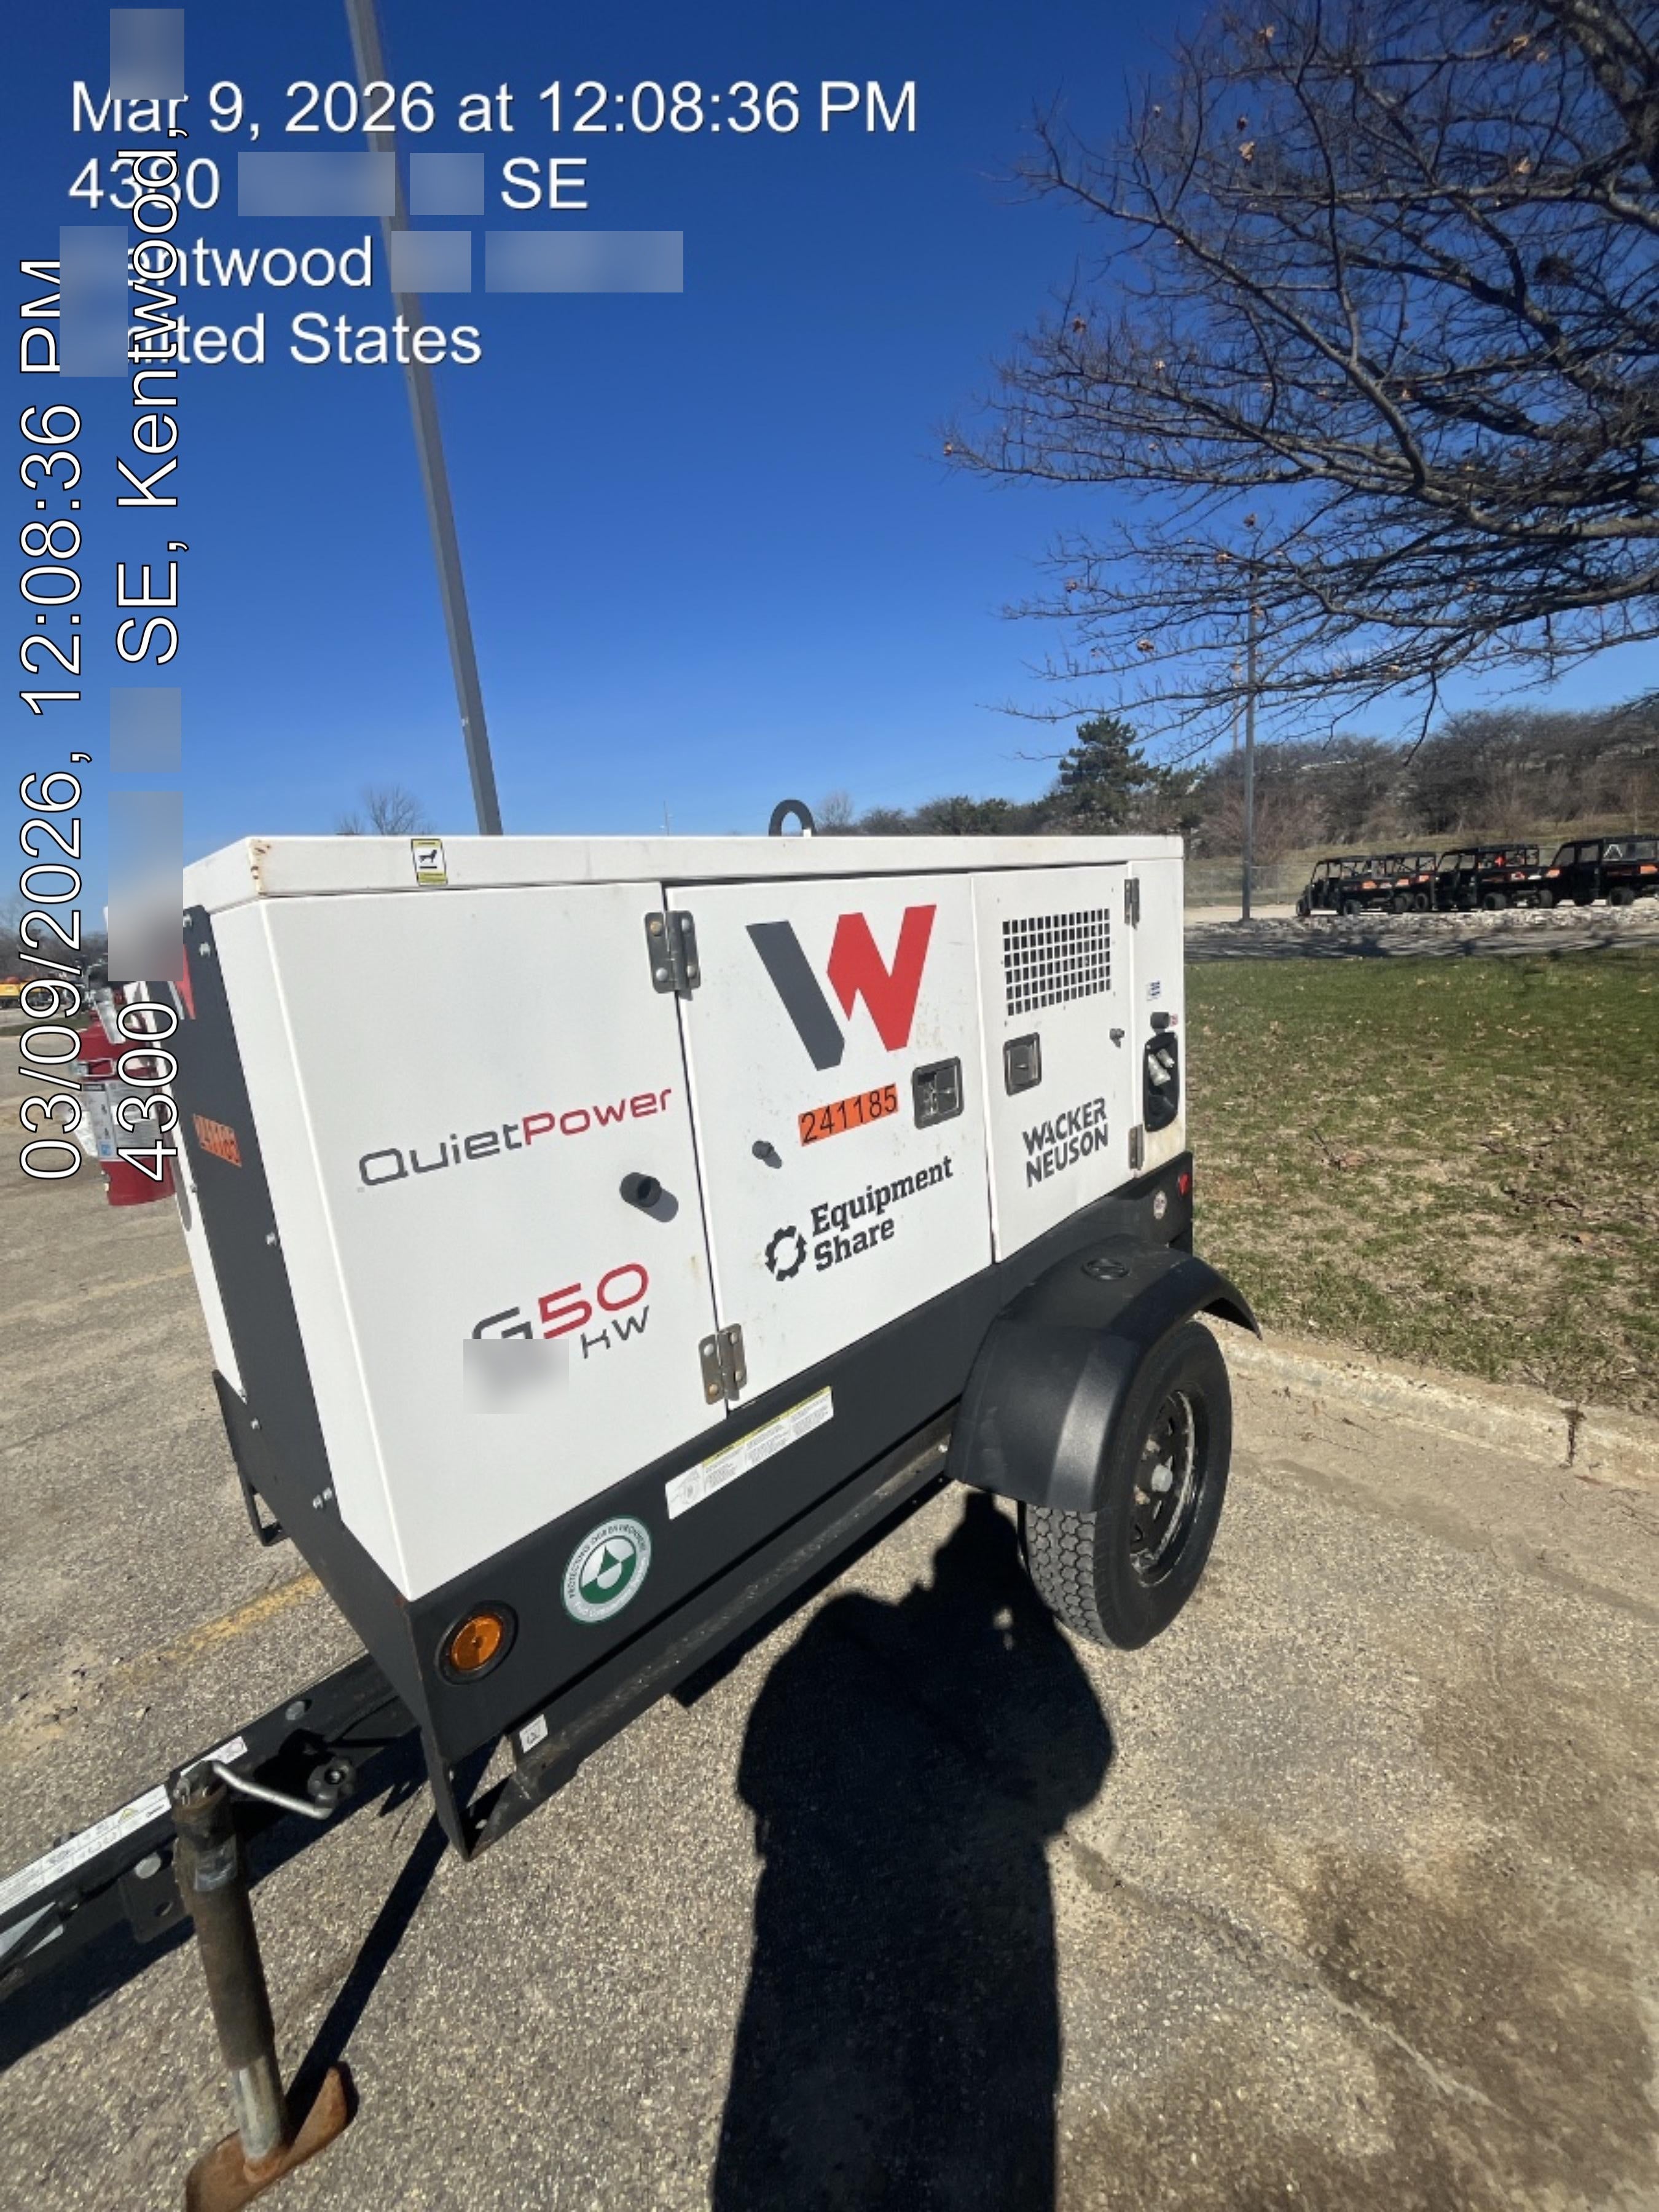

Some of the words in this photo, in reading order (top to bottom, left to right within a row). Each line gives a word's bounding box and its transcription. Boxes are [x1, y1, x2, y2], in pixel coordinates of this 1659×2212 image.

[358, 1088, 672, 1186] QuietPower
[801, 1086, 896, 1143] 241185
[1022, 1097, 1107, 1156] WACKER
[1026, 1123, 1108, 1188] NEUSON
[810, 1155, 954, 1237] Equipment
[814, 1218, 895, 1272] Share
